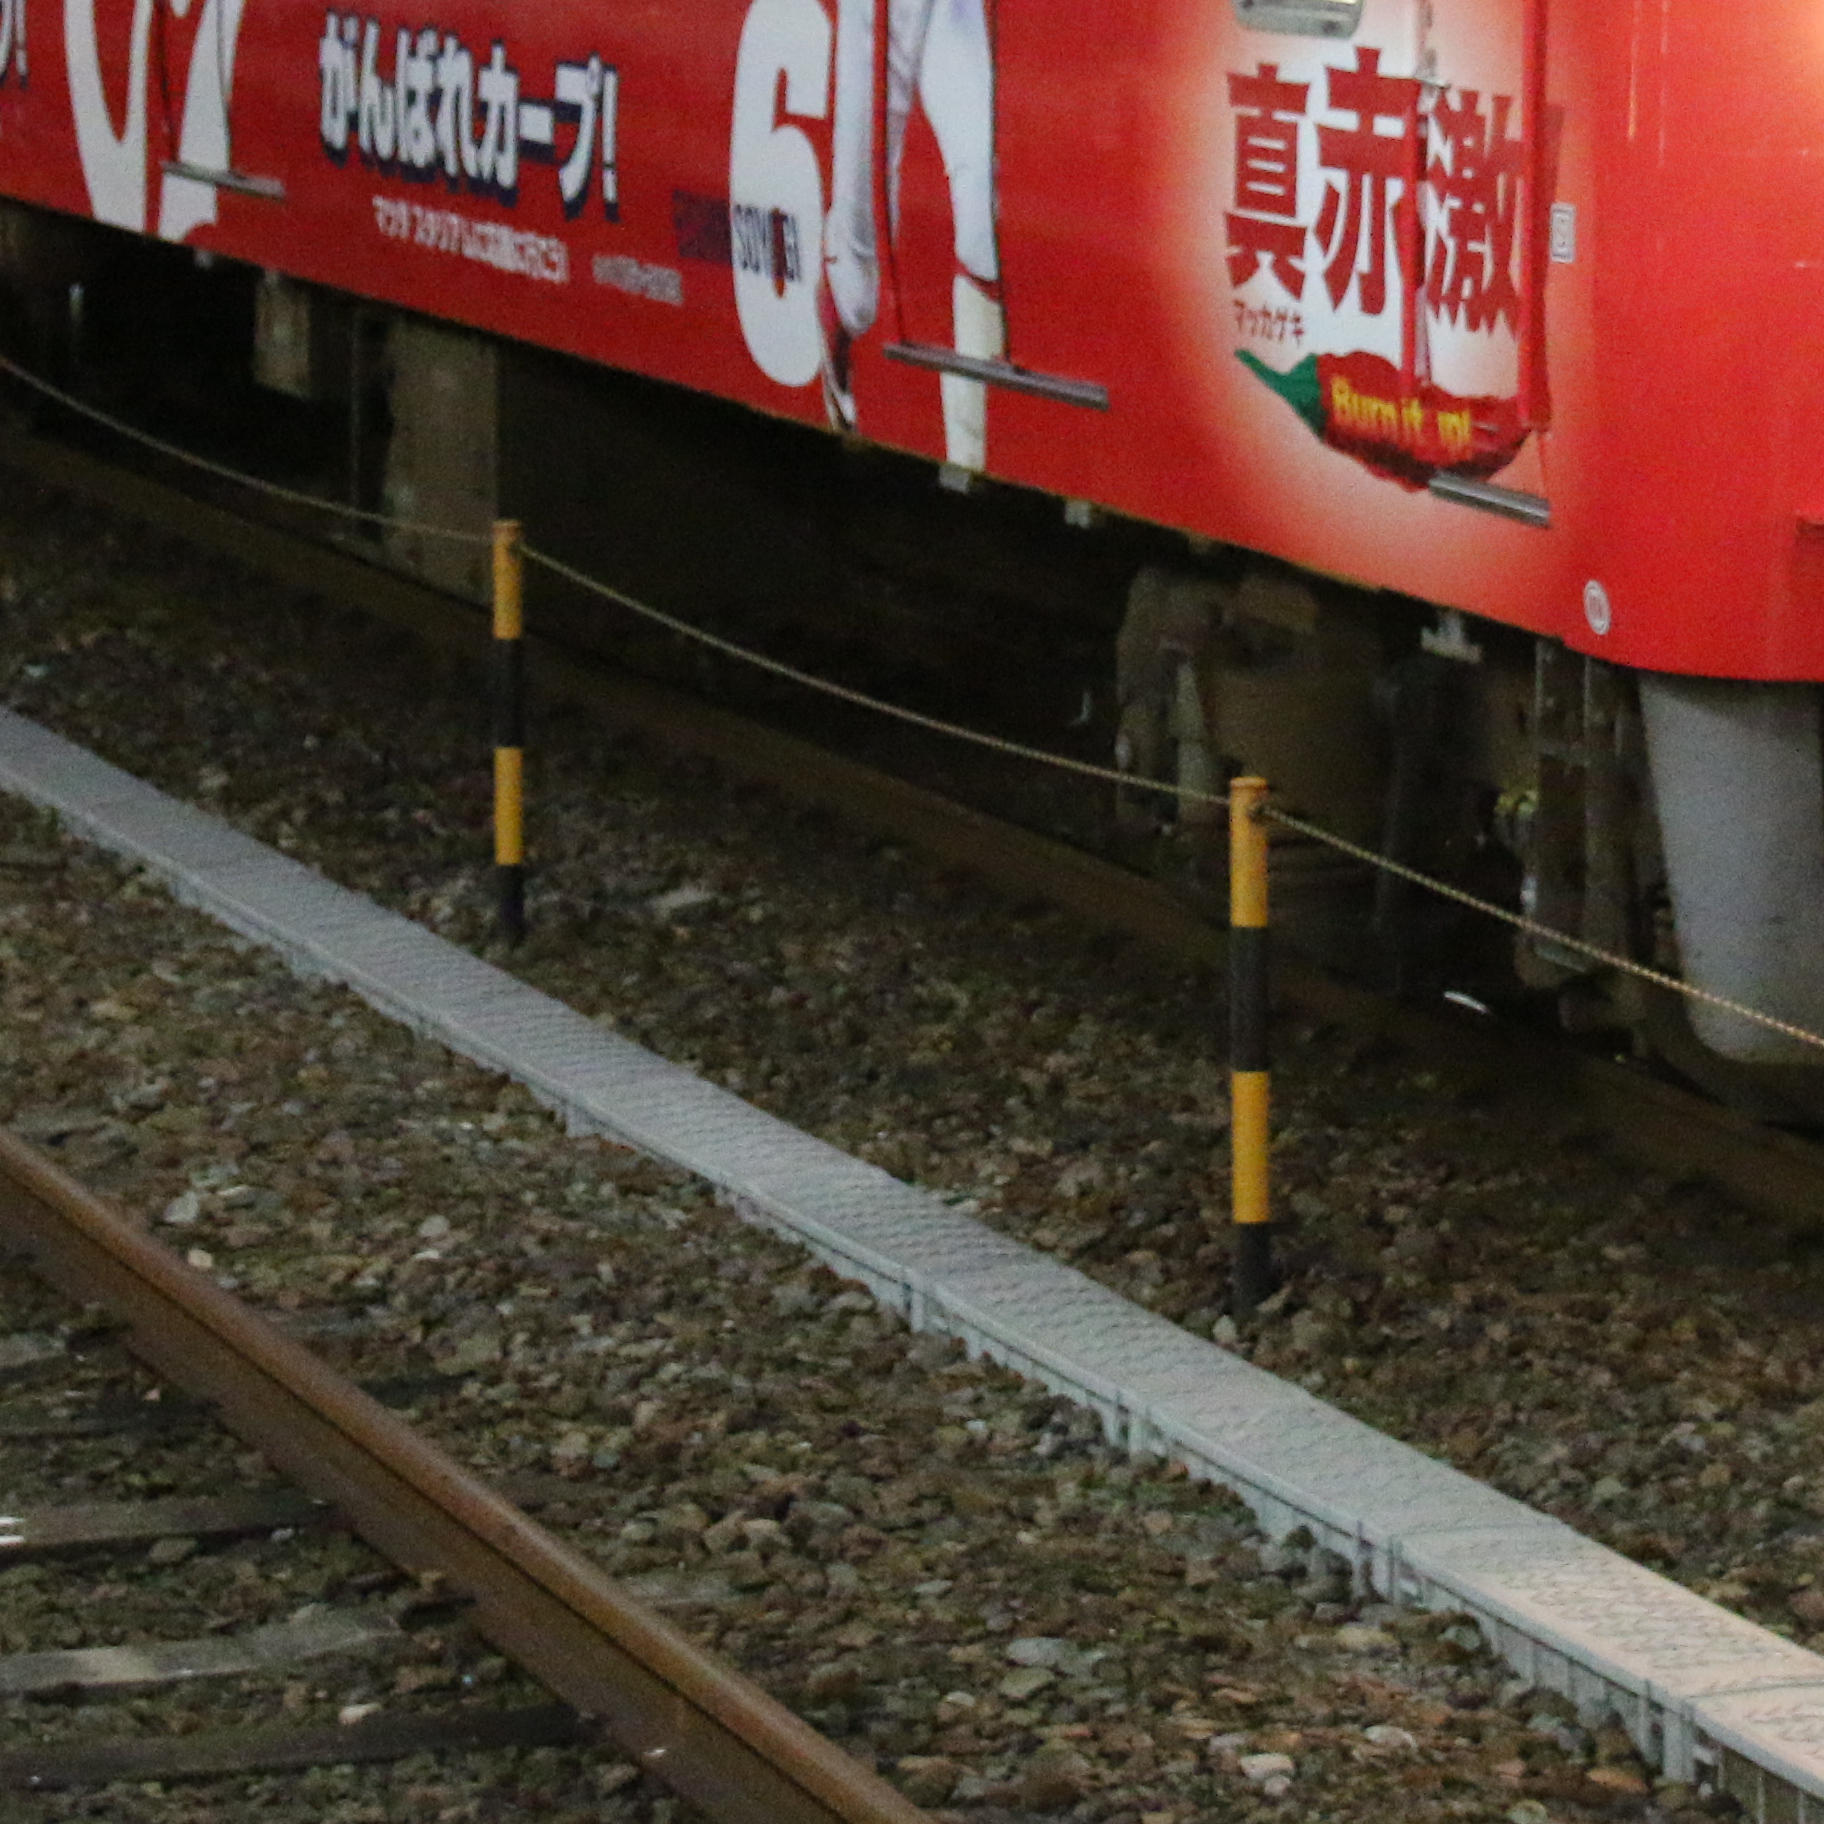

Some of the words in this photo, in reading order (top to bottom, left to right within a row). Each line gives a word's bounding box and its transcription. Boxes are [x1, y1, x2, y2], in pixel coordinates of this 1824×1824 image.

[318, 6, 622, 222] がんばれカープ!
